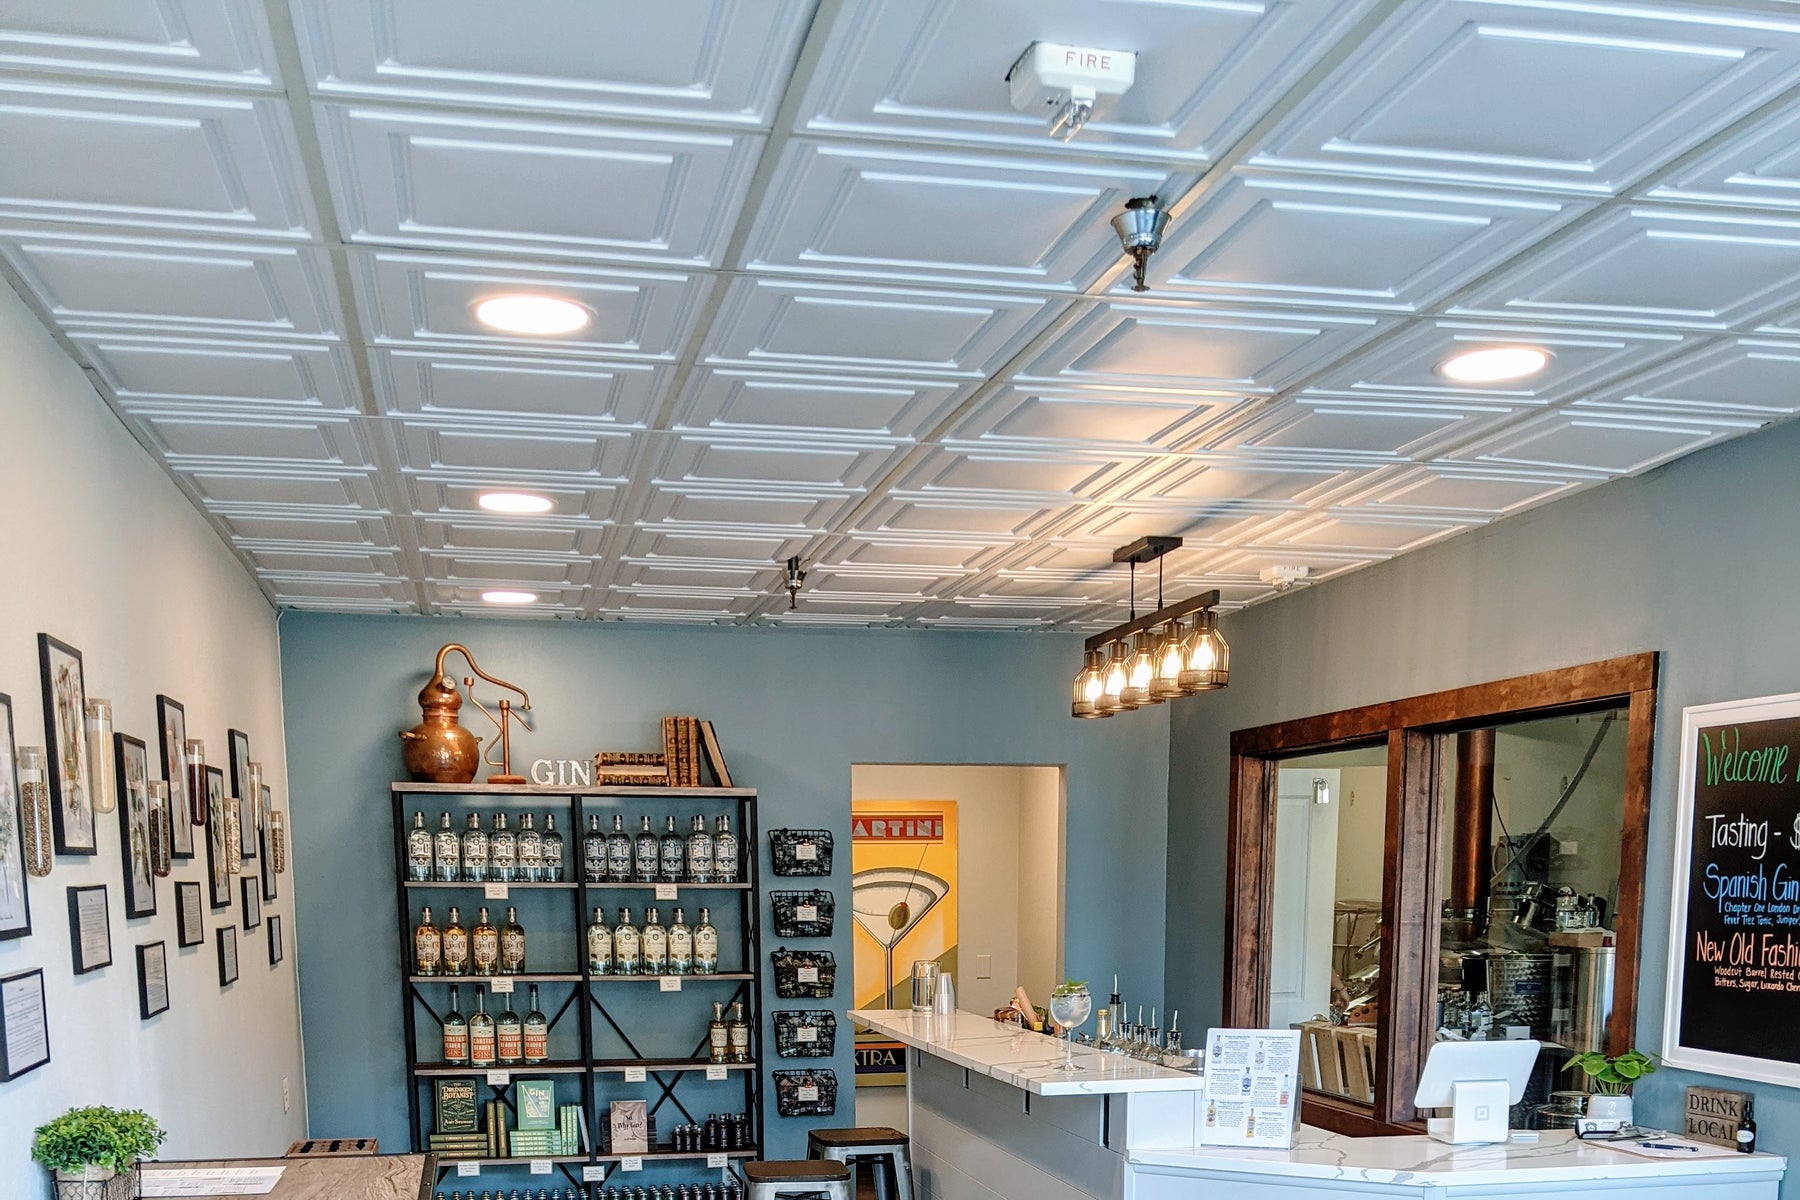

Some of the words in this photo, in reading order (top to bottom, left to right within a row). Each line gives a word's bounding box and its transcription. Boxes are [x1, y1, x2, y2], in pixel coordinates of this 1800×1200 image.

[1066, 51, 1111, 70] FIRE
[1702, 727, 1788, 786] Welcome
[530, 758, 592, 786] GIN
[1705, 813, 1768, 859] Tasting
[1703, 863, 1768, 913] Spanish
[1772, 863, 1799, 902] Gin
[1724, 901, 1752, 916] Chapter
[1753, 902, 1765, 913] One
[1767, 902, 1791, 913] London
[1724, 915, 1740, 926] Fever
[1741, 915, 1755, 926] Tree
[1696, 930, 1726, 962] New
[1729, 932, 1755, 966] Old
[1714, 965, 1742, 977] Woodcut
[1745, 967, 1767, 979] Barrel
[1770, 968, 1795, 981] Rested
[1689, 1094, 1738, 1117] DRINK
[1689, 1118, 1737, 1141] LOCAL
